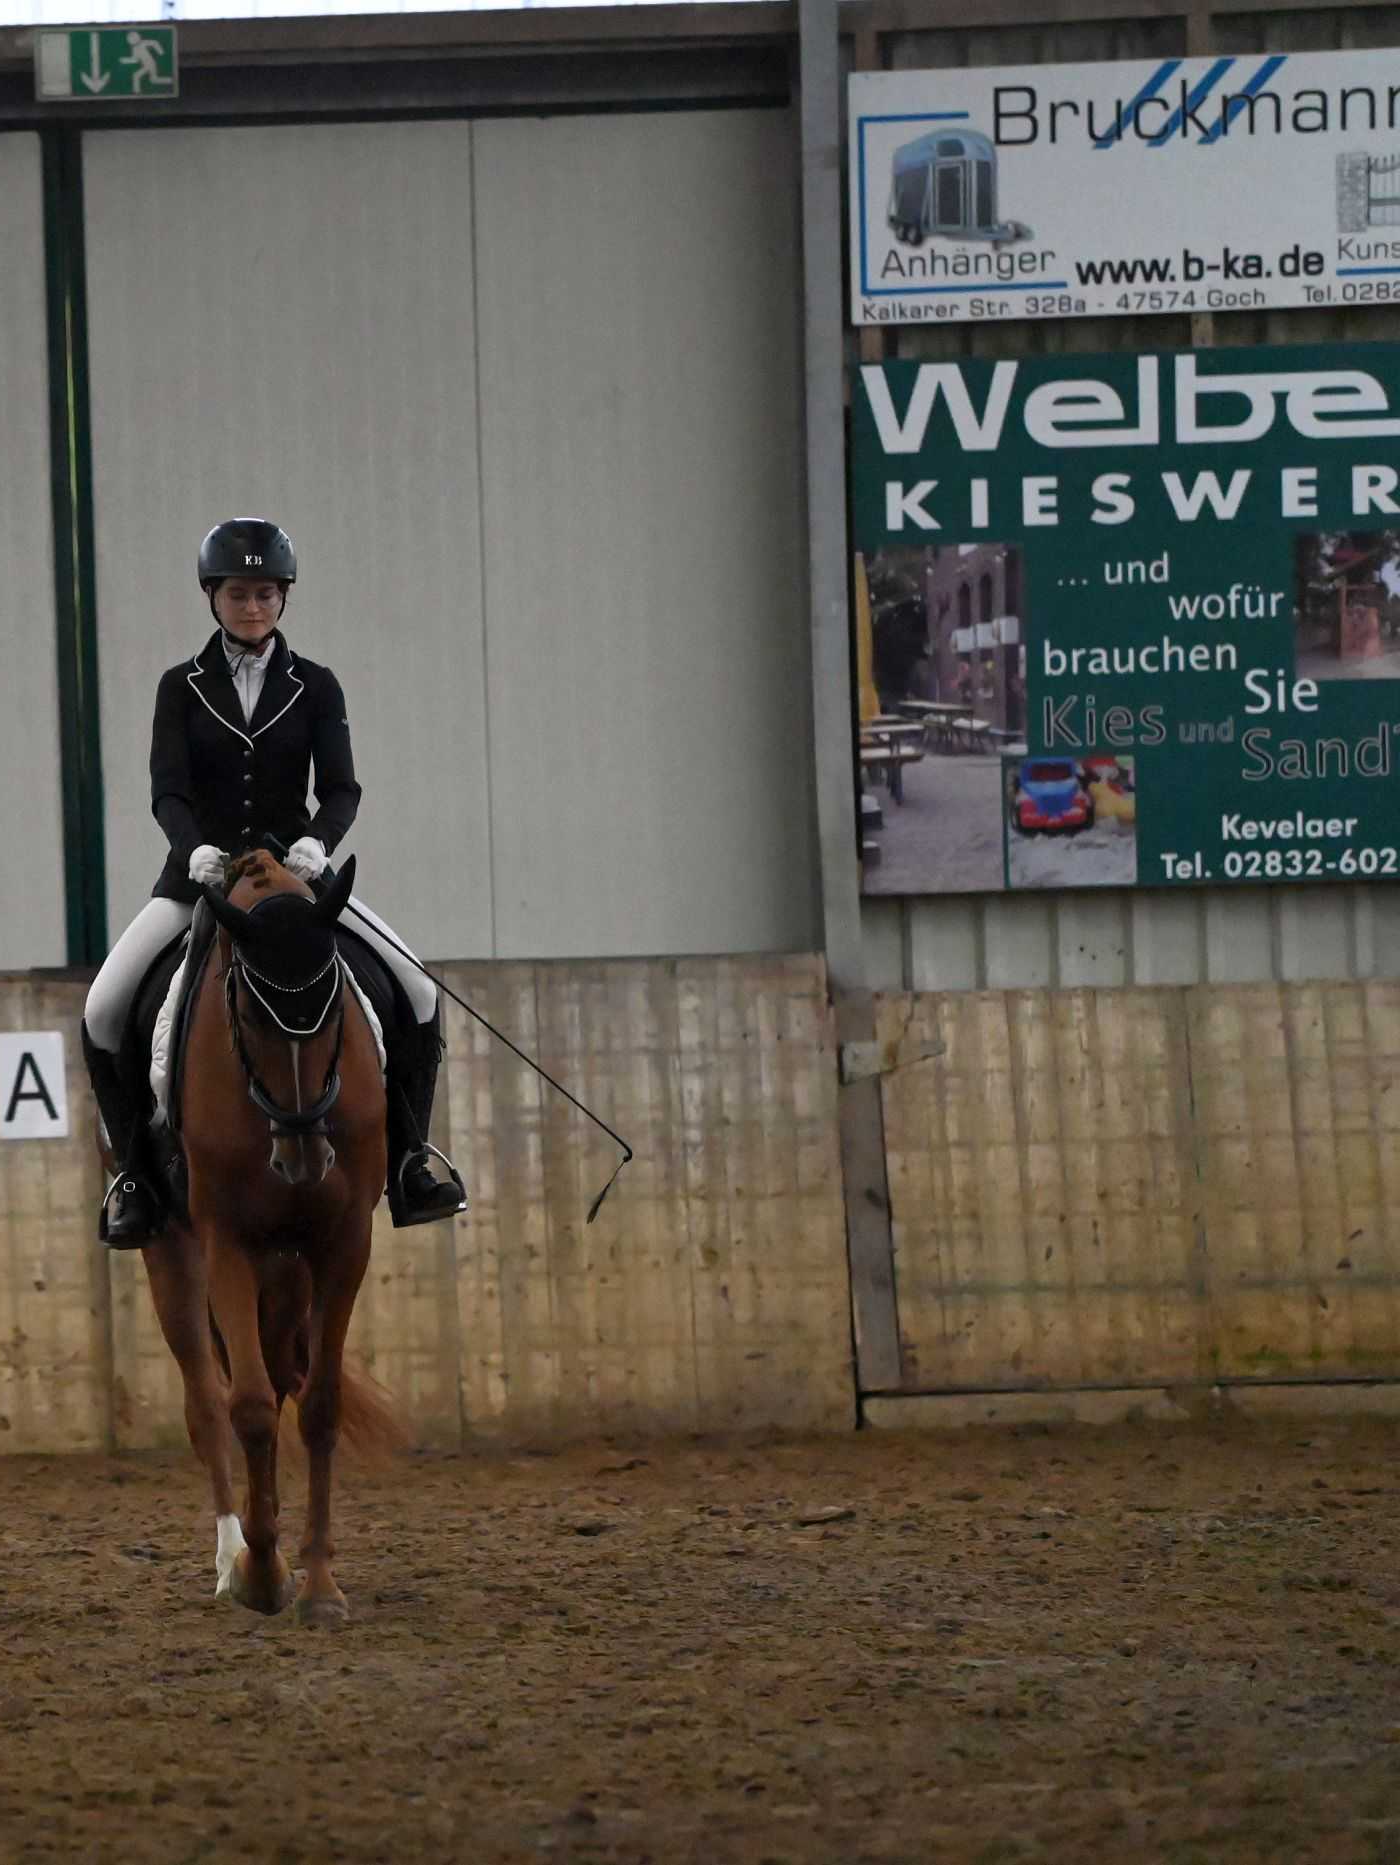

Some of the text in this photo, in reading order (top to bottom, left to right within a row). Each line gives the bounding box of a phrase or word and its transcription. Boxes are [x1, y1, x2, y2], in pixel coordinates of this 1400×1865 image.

[880, 248, 1056, 281] Anhänger
[1075, 244, 1325, 286] www.b-ka.de
[862, 302, 960, 321] Kalkarer
[969, 298, 1011, 317] Str.
[1025, 295, 1087, 315] 328a
[1115, 290, 1197, 310] 47574
[1207, 288, 1266, 307] Goch
[860, 354, 1400, 454] Welbe
[885, 464, 1400, 533] KIESWER
[1103, 550, 1170, 586] und
[1168, 584, 1285, 620] wofür
[1043, 637, 1237, 676] brauchen
[1243, 669, 1319, 714] Sie
[1042, 695, 1235, 748] Kies und
[1221, 811, 1358, 840] Kevelaer
[1160, 847, 1399, 879] Tel. 02832-602
[4, 1051, 59, 1122] A
